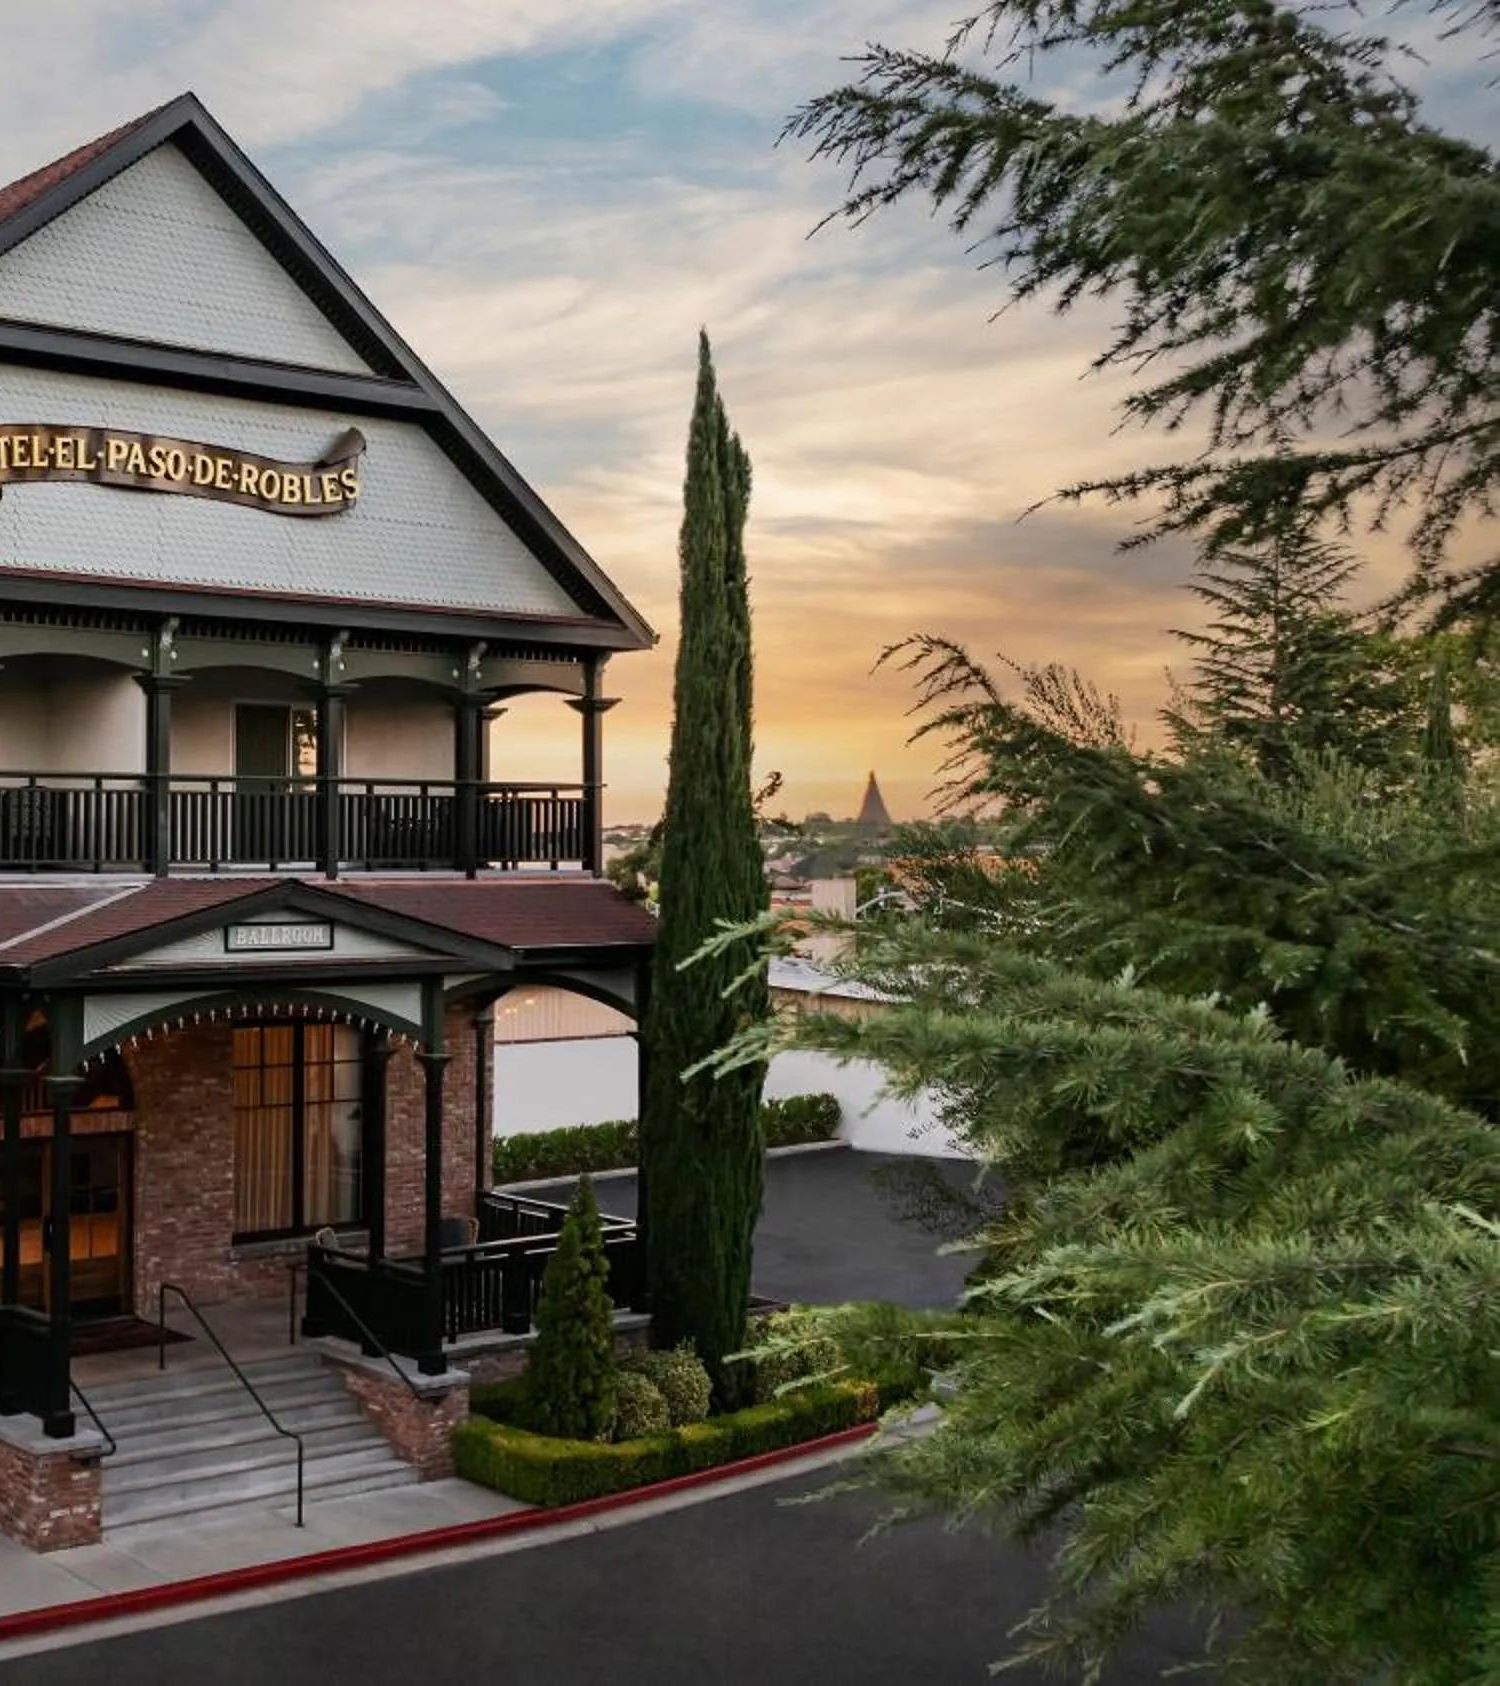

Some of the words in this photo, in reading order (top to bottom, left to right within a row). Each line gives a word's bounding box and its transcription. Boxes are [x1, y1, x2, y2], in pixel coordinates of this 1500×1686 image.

[55, 436, 95, 470] EL
[105, 439, 188, 477] PASO
[194, 454, 232, 489] DE
[240, 463, 358, 504] ROBLES
[236, 927, 324, 945] BALLROOM
